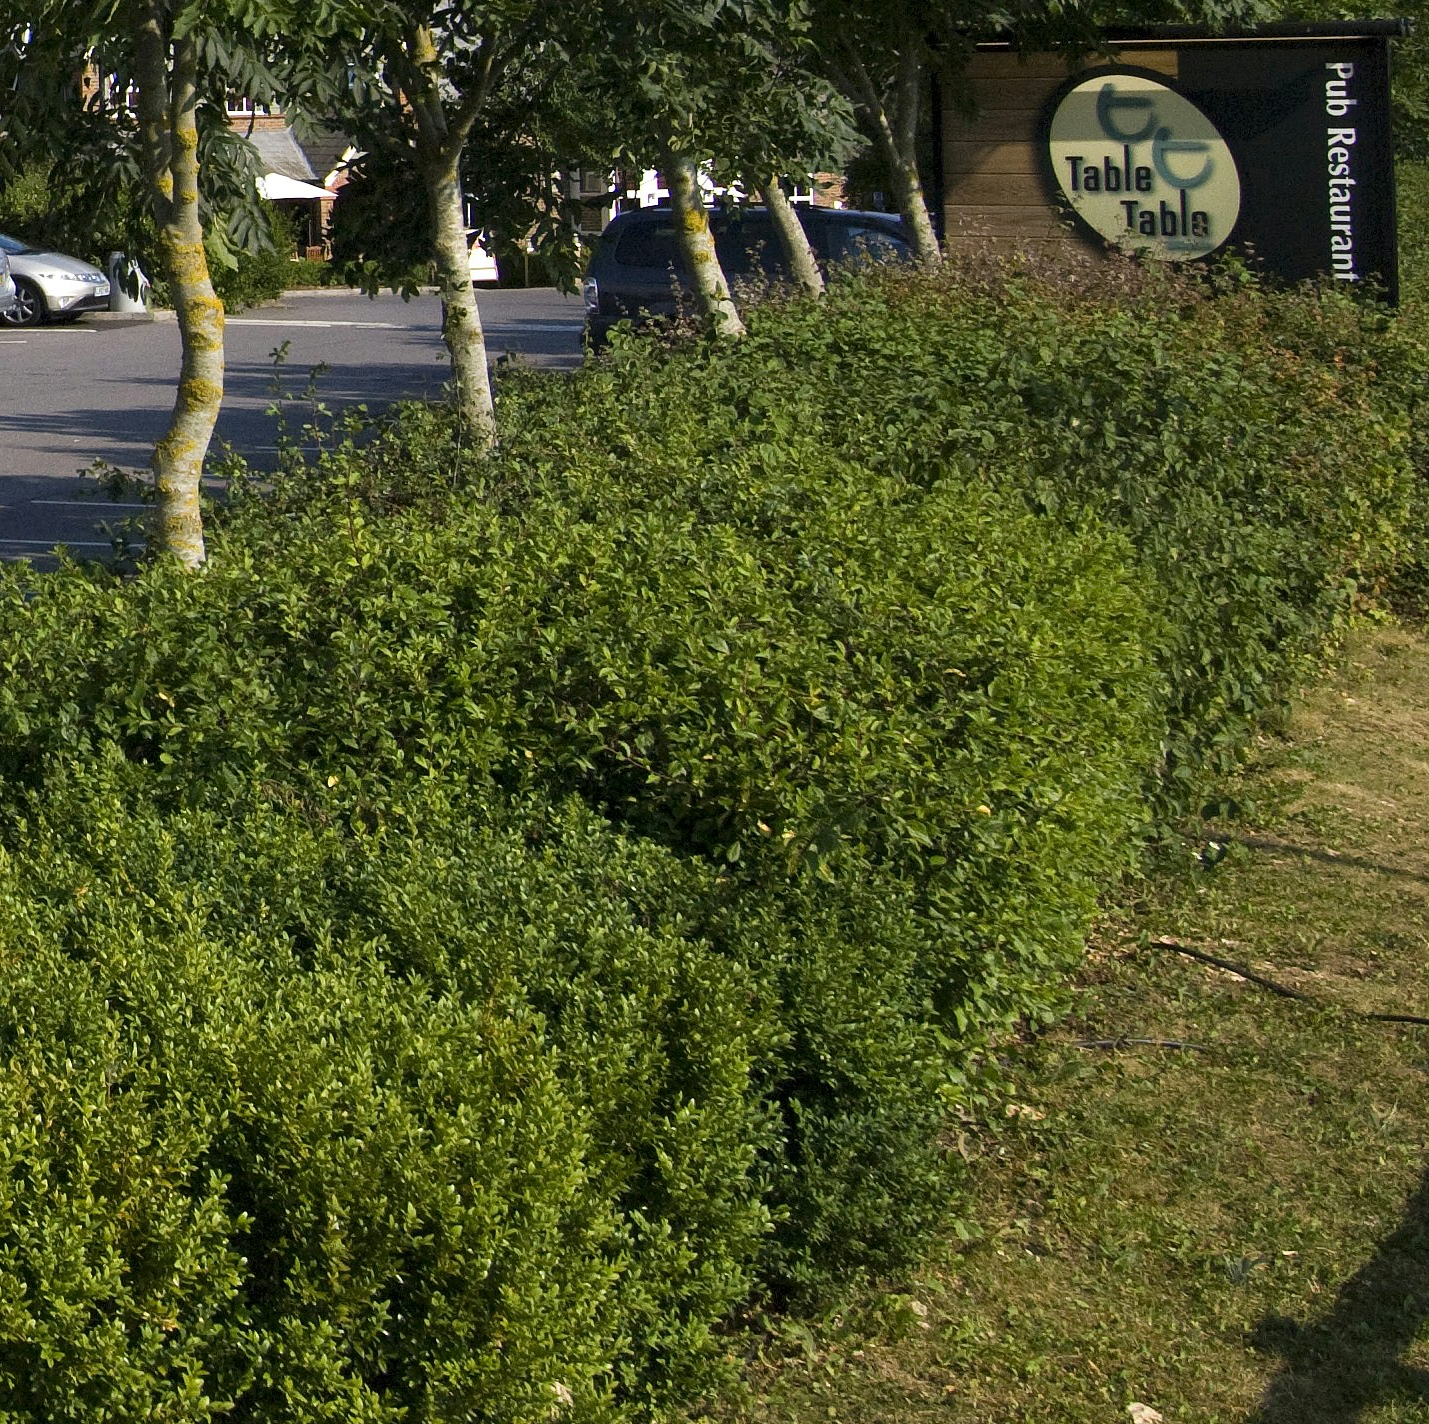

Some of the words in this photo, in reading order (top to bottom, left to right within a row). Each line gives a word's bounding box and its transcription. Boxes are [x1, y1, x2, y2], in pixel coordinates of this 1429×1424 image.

[1325, 62, 1358, 117] Pub
[1065, 144, 1151, 192] Table
[1120, 189, 1208, 237] Table
[1327, 127, 1360, 283] Restaurant
